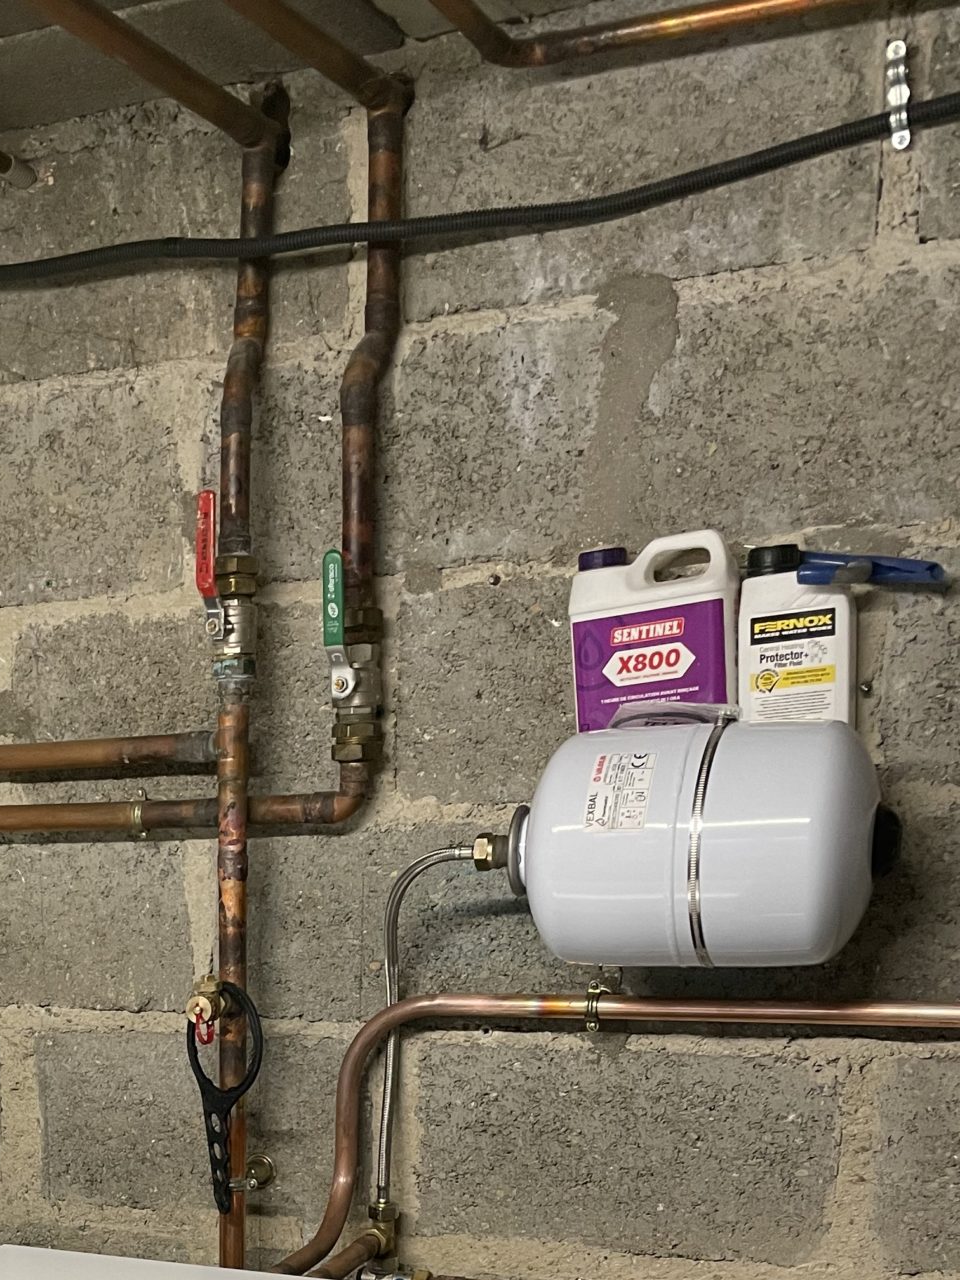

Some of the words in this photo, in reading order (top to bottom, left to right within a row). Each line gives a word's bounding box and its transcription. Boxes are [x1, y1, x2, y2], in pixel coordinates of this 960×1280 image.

[613, 620, 681, 644] SENTINEL
[754, 614, 833, 633] FERNOX
[616, 648, 681, 675] X800
[584, 791, 598, 828] VEXBAL
